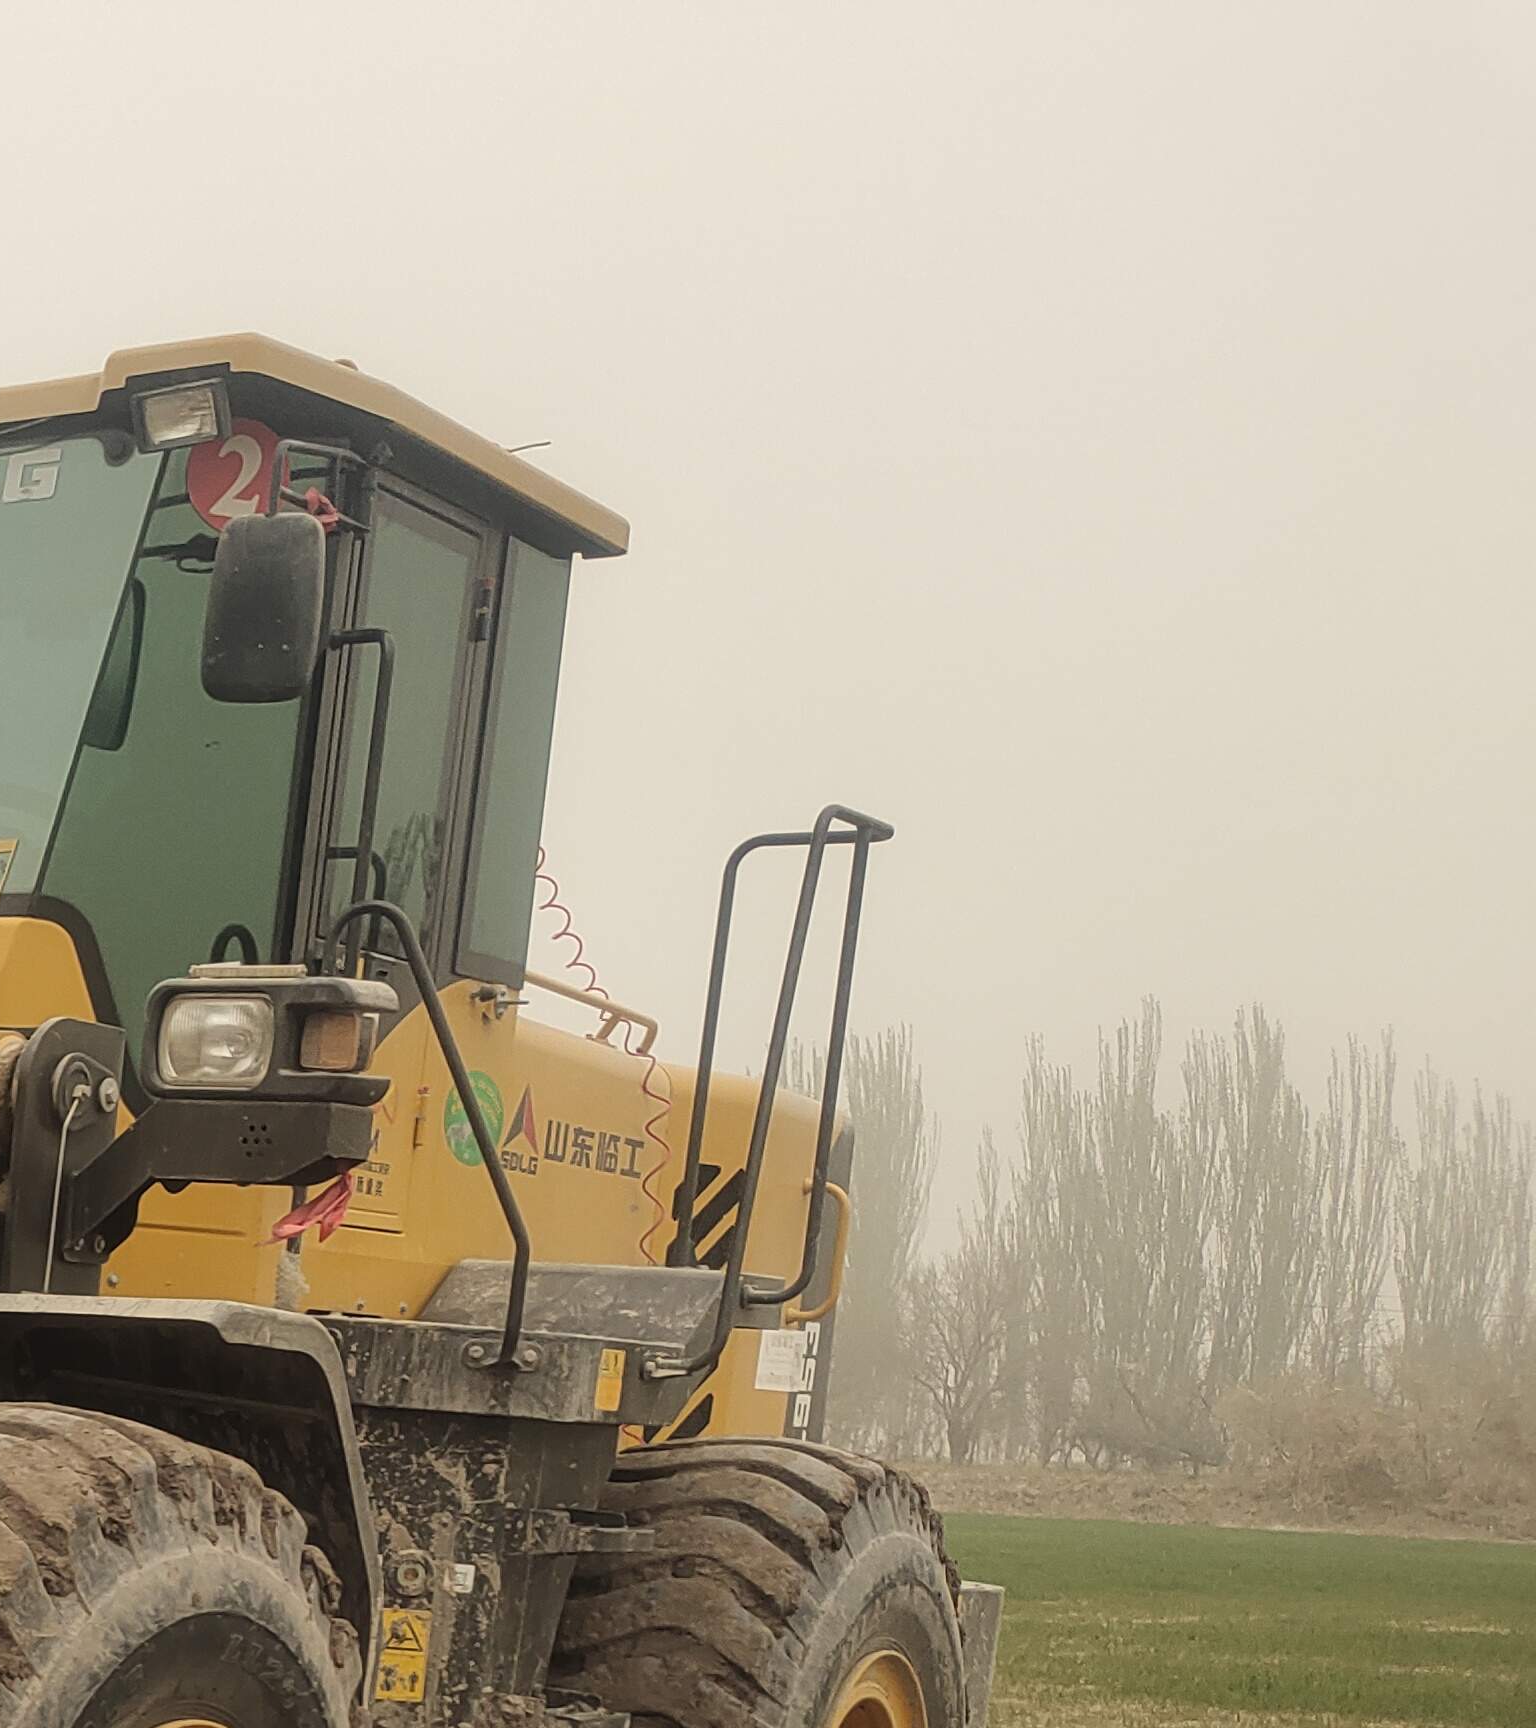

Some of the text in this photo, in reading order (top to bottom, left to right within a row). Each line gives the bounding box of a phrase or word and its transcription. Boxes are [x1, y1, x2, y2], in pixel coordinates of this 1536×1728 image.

[208, 433, 263, 518] 2
[500, 1150, 539, 1176] SDLG
[543, 1119, 646, 1180] 山东临工
